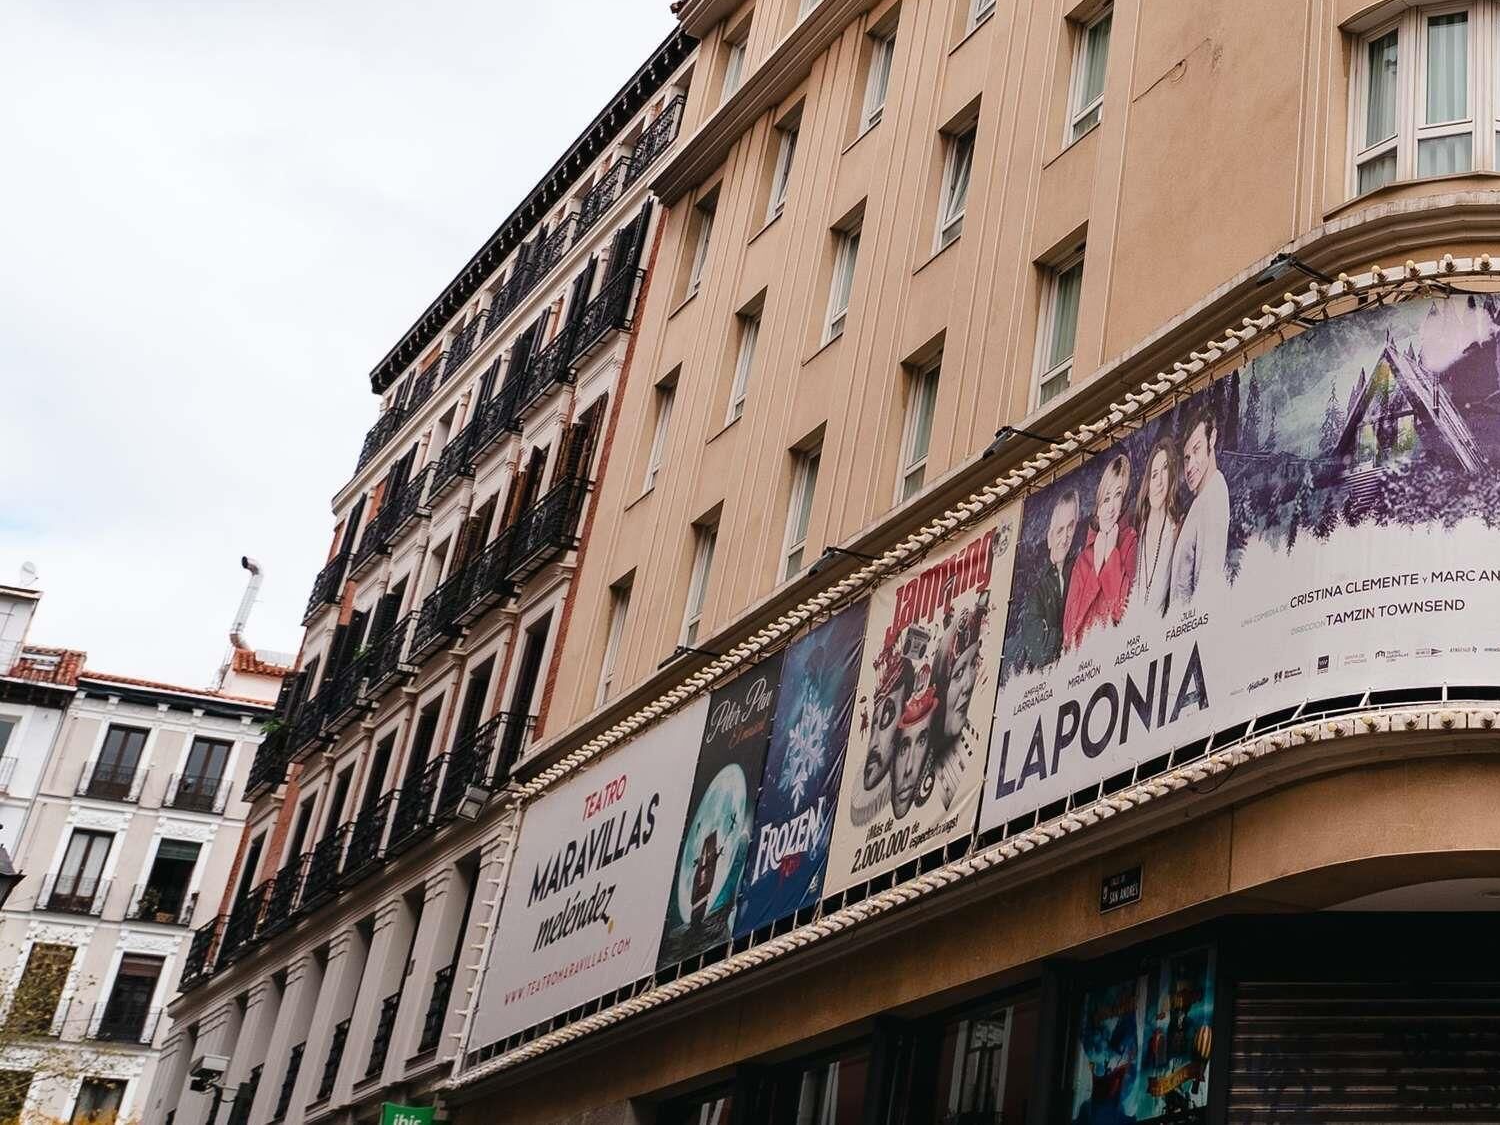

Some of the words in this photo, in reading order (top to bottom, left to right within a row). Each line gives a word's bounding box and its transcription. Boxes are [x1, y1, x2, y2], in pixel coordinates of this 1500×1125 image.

[1290, 585, 1343, 609] CRISTINA
[1345, 573, 1419, 595] CLEMENTE
[1431, 570, 1475, 583] MARC
[1326, 607, 1375, 626] TAMZIN
[1378, 599, 1466, 618] TOWNSEND
[1114, 643, 1150, 667] ABASCAL
[995, 641, 1210, 800] LAPONIA
[583, 775, 627, 821] TEATRO
[527, 793, 660, 908] MARAVILLAS
[751, 796, 826, 887] FROZEN
[851, 826, 910, 874] 2.000.000
[533, 880, 616, 953] meléndez
